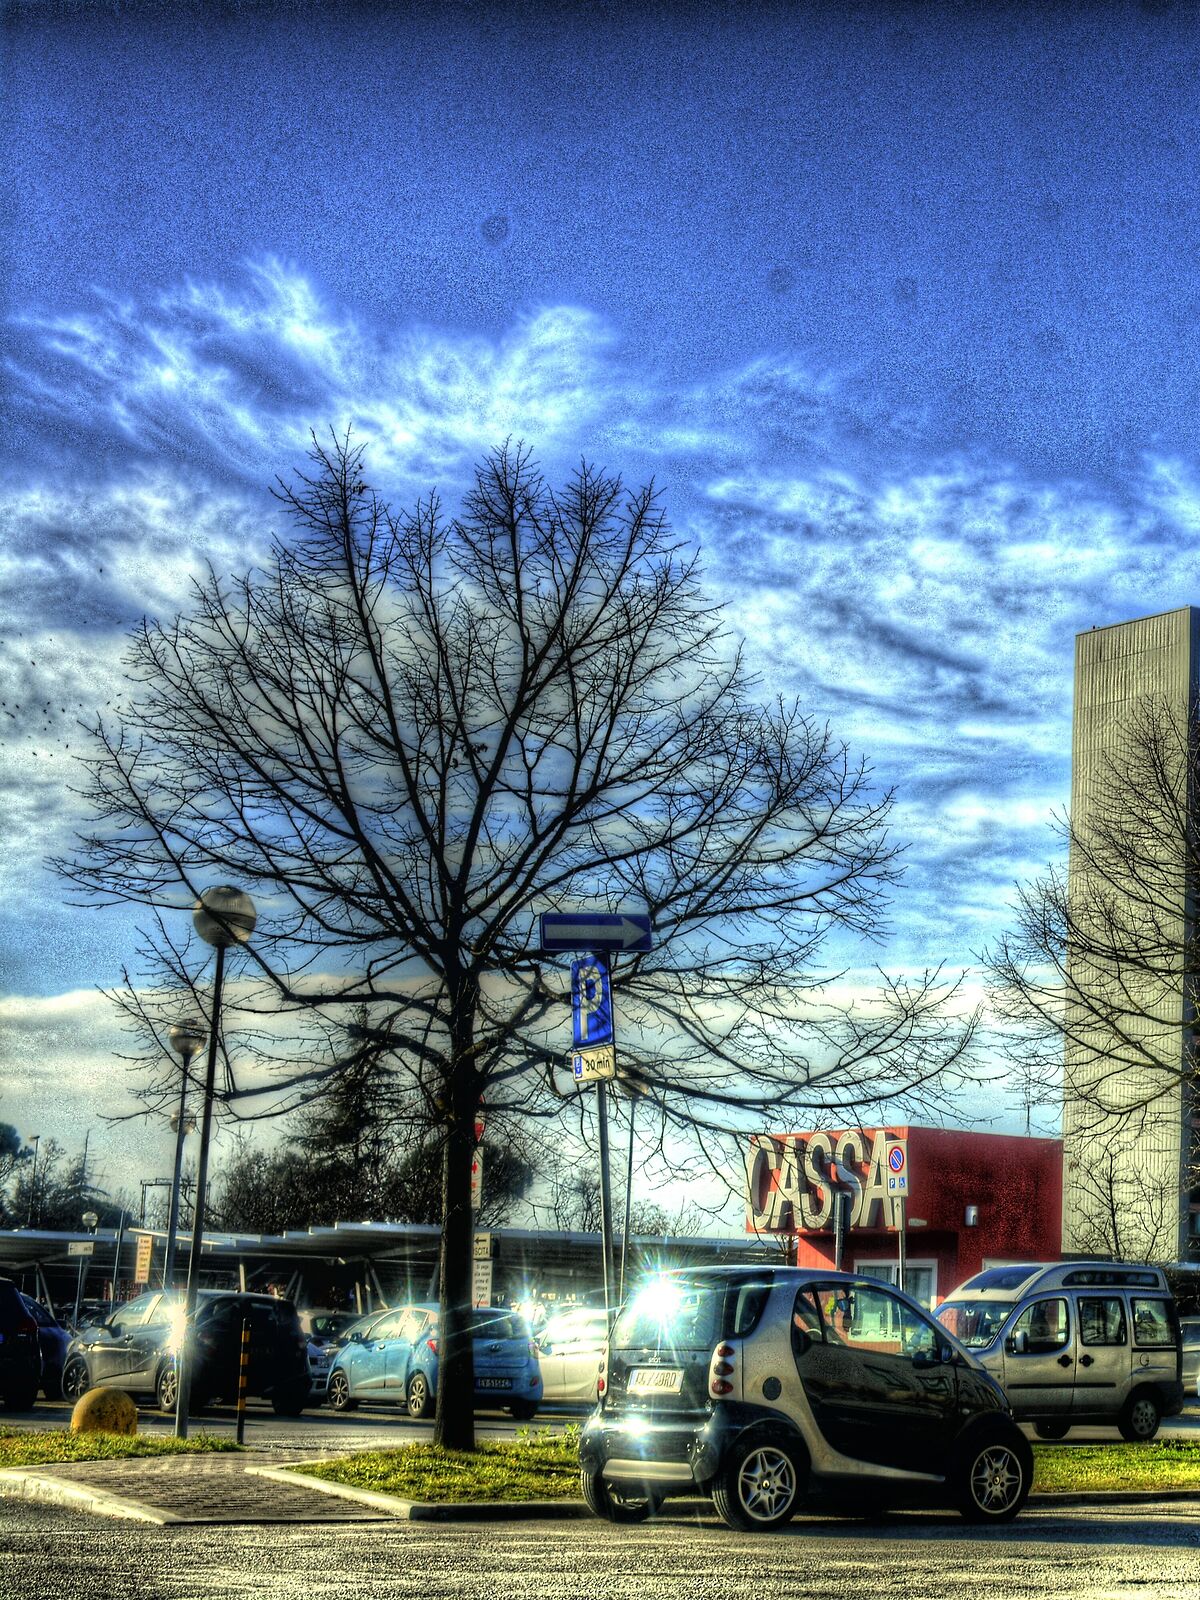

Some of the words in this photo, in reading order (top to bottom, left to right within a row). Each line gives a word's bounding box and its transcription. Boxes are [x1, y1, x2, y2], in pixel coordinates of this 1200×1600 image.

[578, 965, 603, 1041] P
[585, 1059, 596, 1072] 30
[597, 1056, 610, 1070] min
[746, 1130, 894, 1230] CASSA
